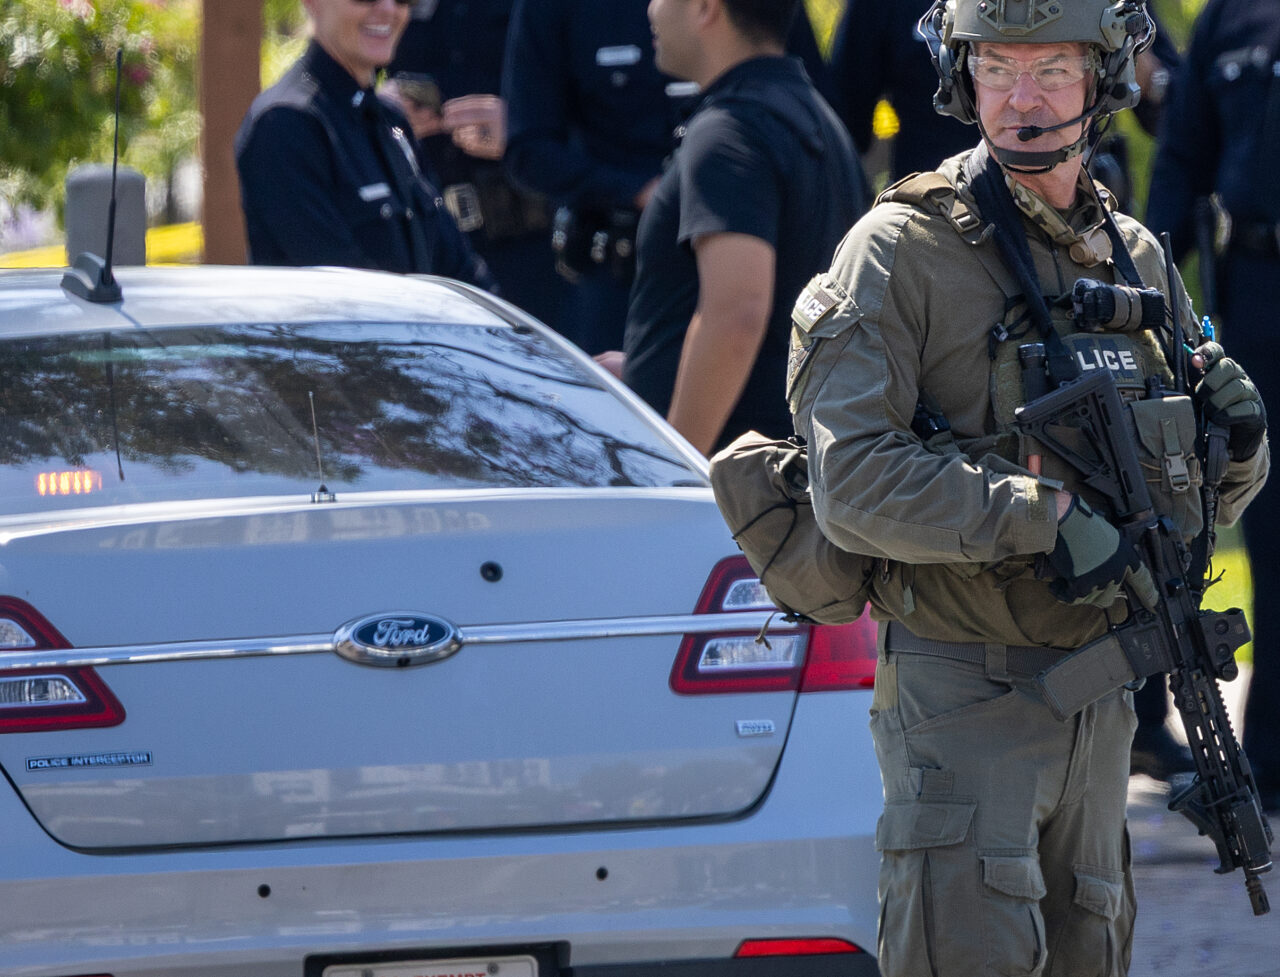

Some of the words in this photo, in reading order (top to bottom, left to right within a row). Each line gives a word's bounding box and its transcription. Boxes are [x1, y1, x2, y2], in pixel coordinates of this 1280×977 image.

[1076, 349, 1138, 371] LICE
[373, 618, 430, 646] Ford
[30, 759, 68, 768] POLICE
